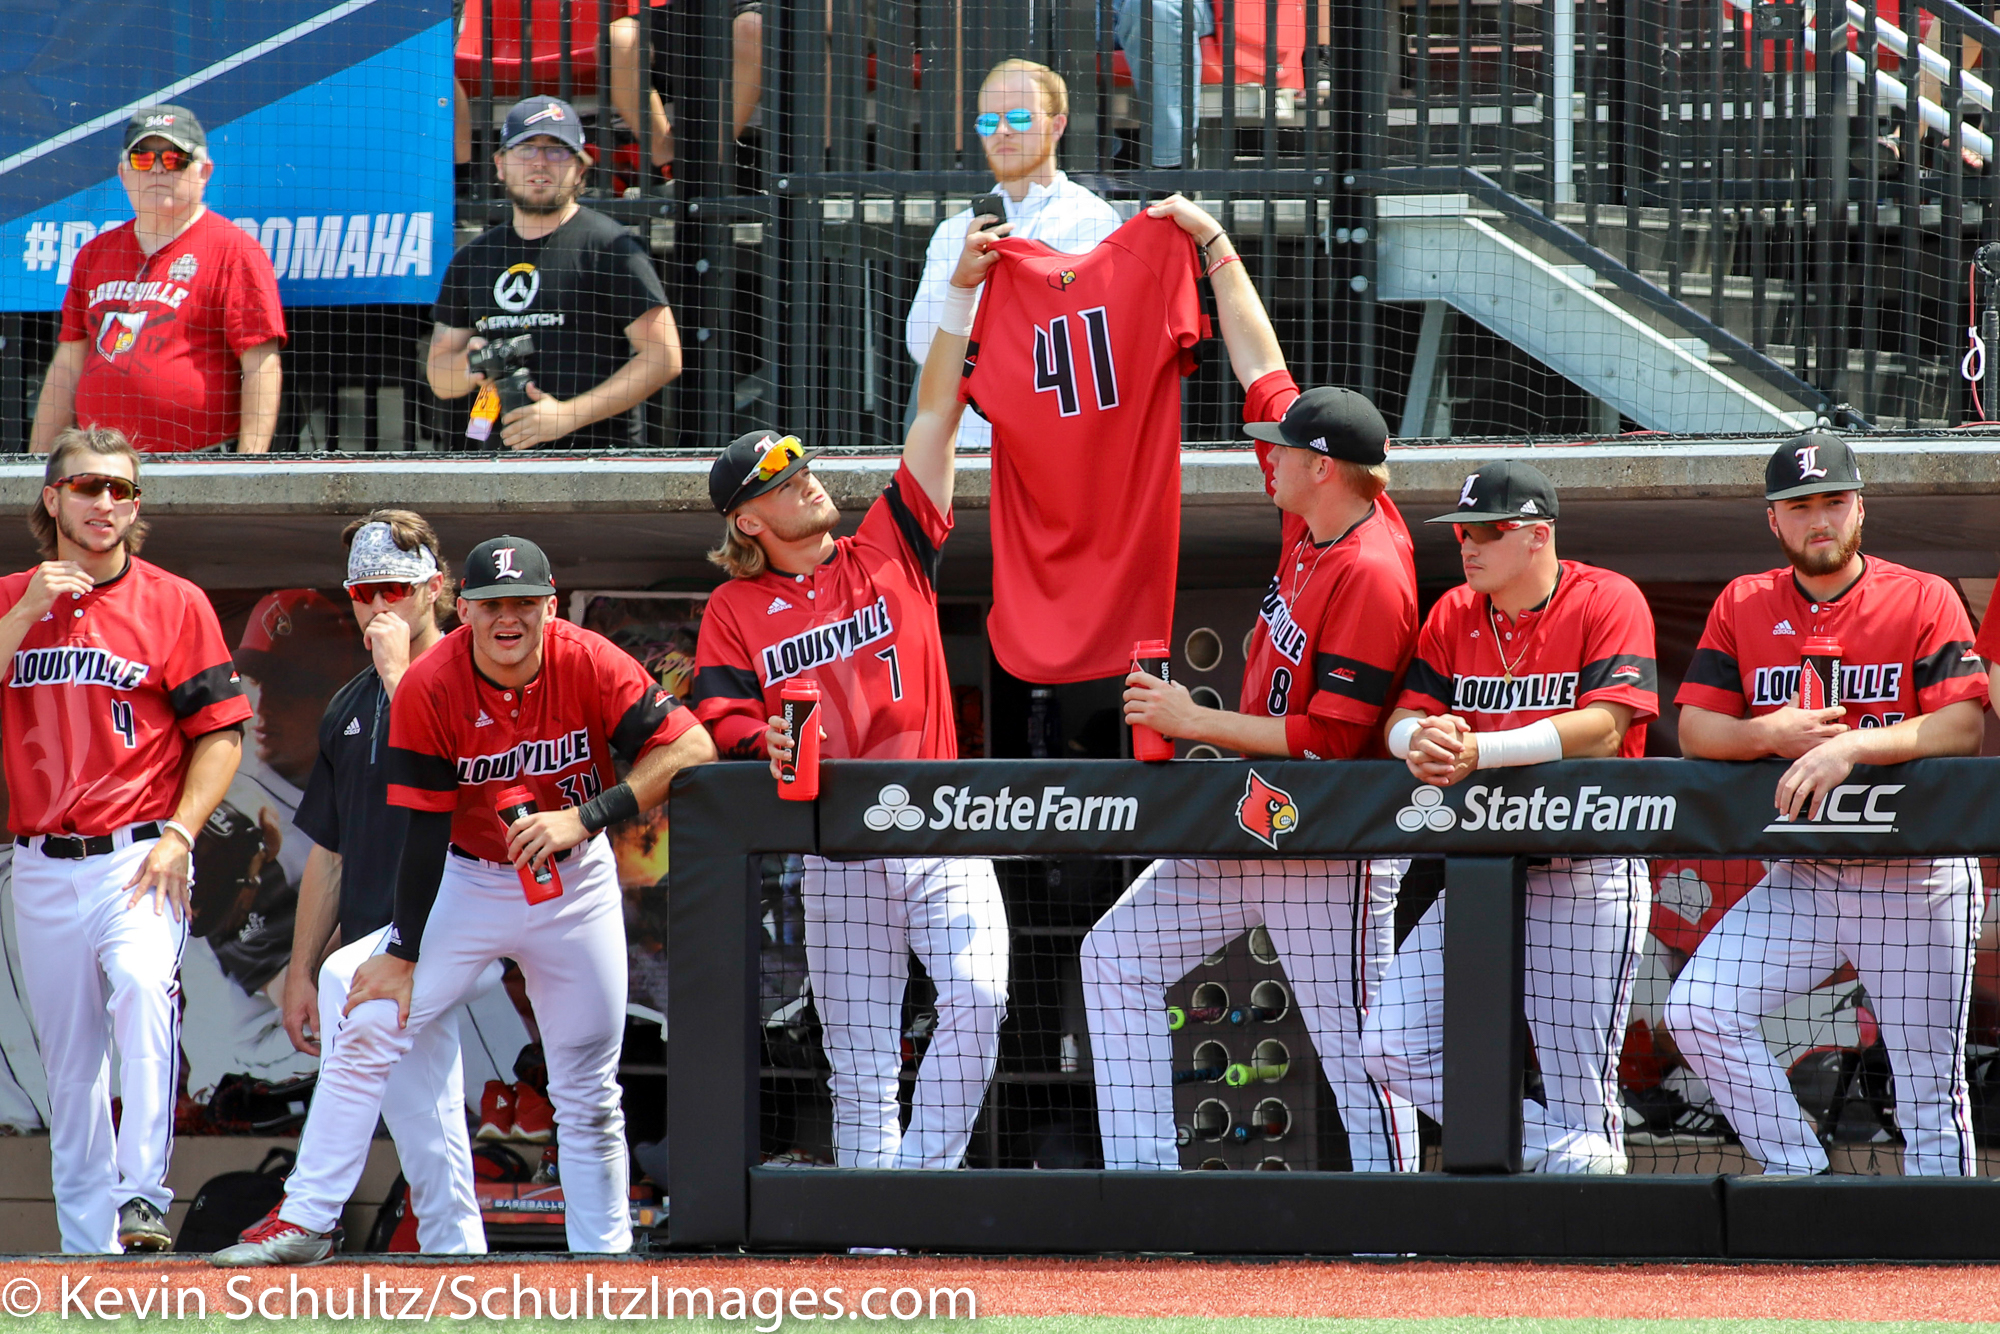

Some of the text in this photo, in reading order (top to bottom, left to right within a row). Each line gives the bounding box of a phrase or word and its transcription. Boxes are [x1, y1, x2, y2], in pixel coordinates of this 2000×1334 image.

[88, 280, 190, 309] LOUISVILLE
[1032, 305, 1120, 418] 41
[1795, 445, 1828, 480] L
[1457, 473, 1480, 508] L
[491, 547, 524, 580] L
[767, 603, 793, 615] adidas
[762, 594, 894, 689] LOUISVILLE
[8, 645, 150, 692] LOUISVILLE
[874, 644, 904, 702] 7
[1331, 666, 1357, 681] ACC
[1751, 662, 1903, 706] LOUILLE
[1803, 668, 1813, 710] ODYARMOR
[1830, 659, 1841, 708] DYARMOR
[1267, 665, 1293, 717] 8
[111, 698, 136, 748] 4
[494, 1199, 565, 1210] BASEBALLS
